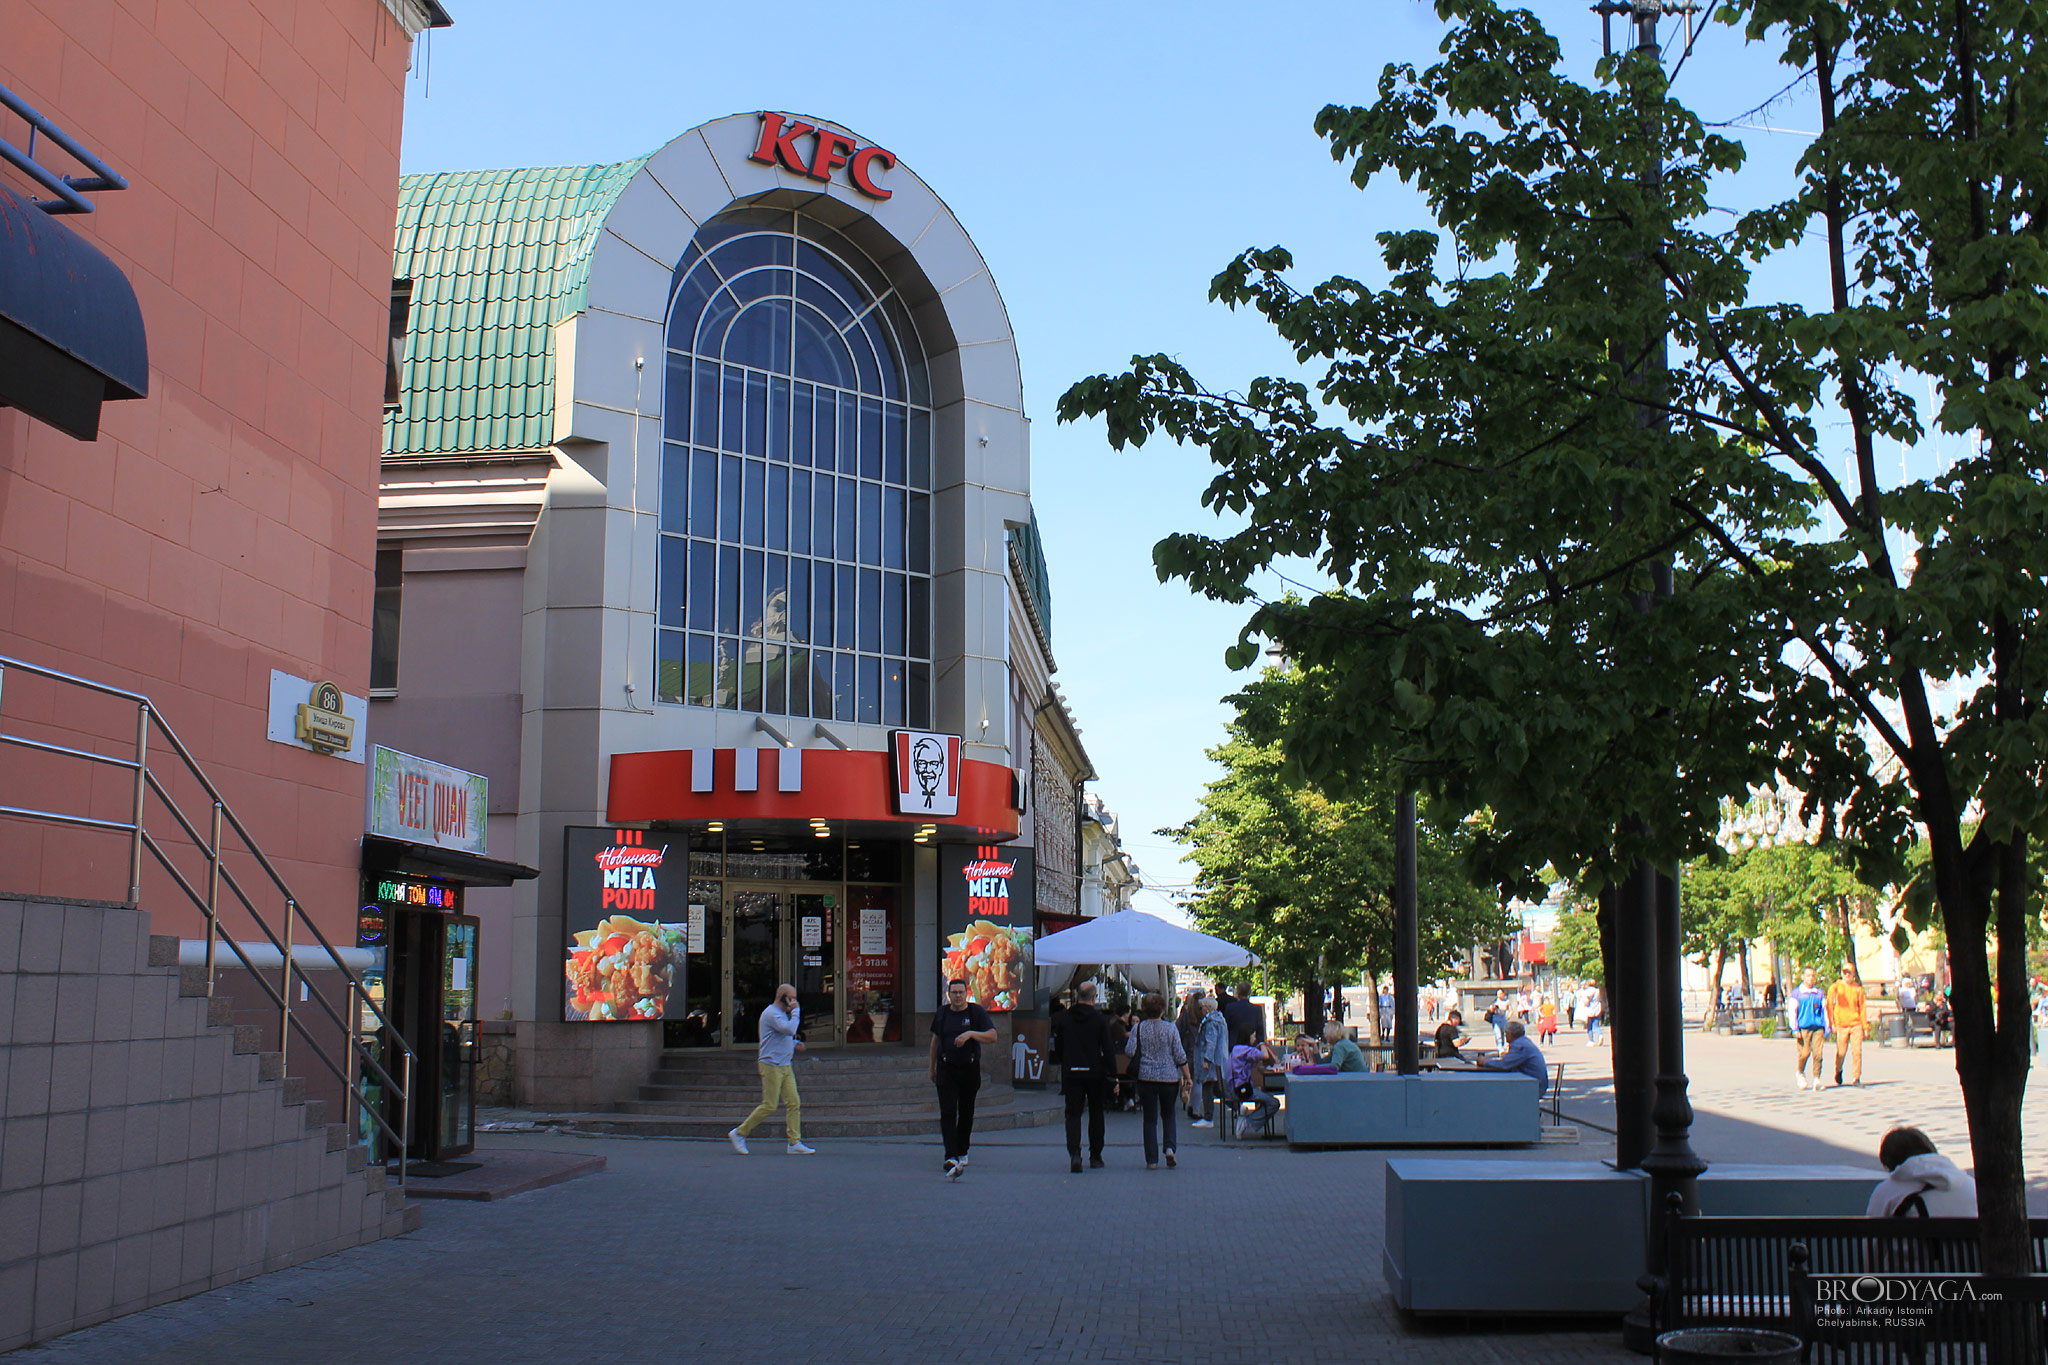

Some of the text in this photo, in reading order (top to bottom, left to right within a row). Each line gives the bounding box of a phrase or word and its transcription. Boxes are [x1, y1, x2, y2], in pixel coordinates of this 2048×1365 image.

[748, 110, 896, 200] KFC
[323, 692, 336, 710] 86
[598, 844, 669, 869] Новинка!
[603, 866, 657, 890] МЕГА
[963, 858, 1017, 880] Новинка!
[378, 880, 406, 903] КУХНЯ
[407, 884, 426, 906] ТОМ
[428, 886, 442, 907] ЯМ
[968, 877, 1009, 898] МЕГА
[602, 888, 655, 910] РОЛЛ
[968, 896, 1009, 916] РОЛЛ
[856, 956, 888, 967] 3 этаж
